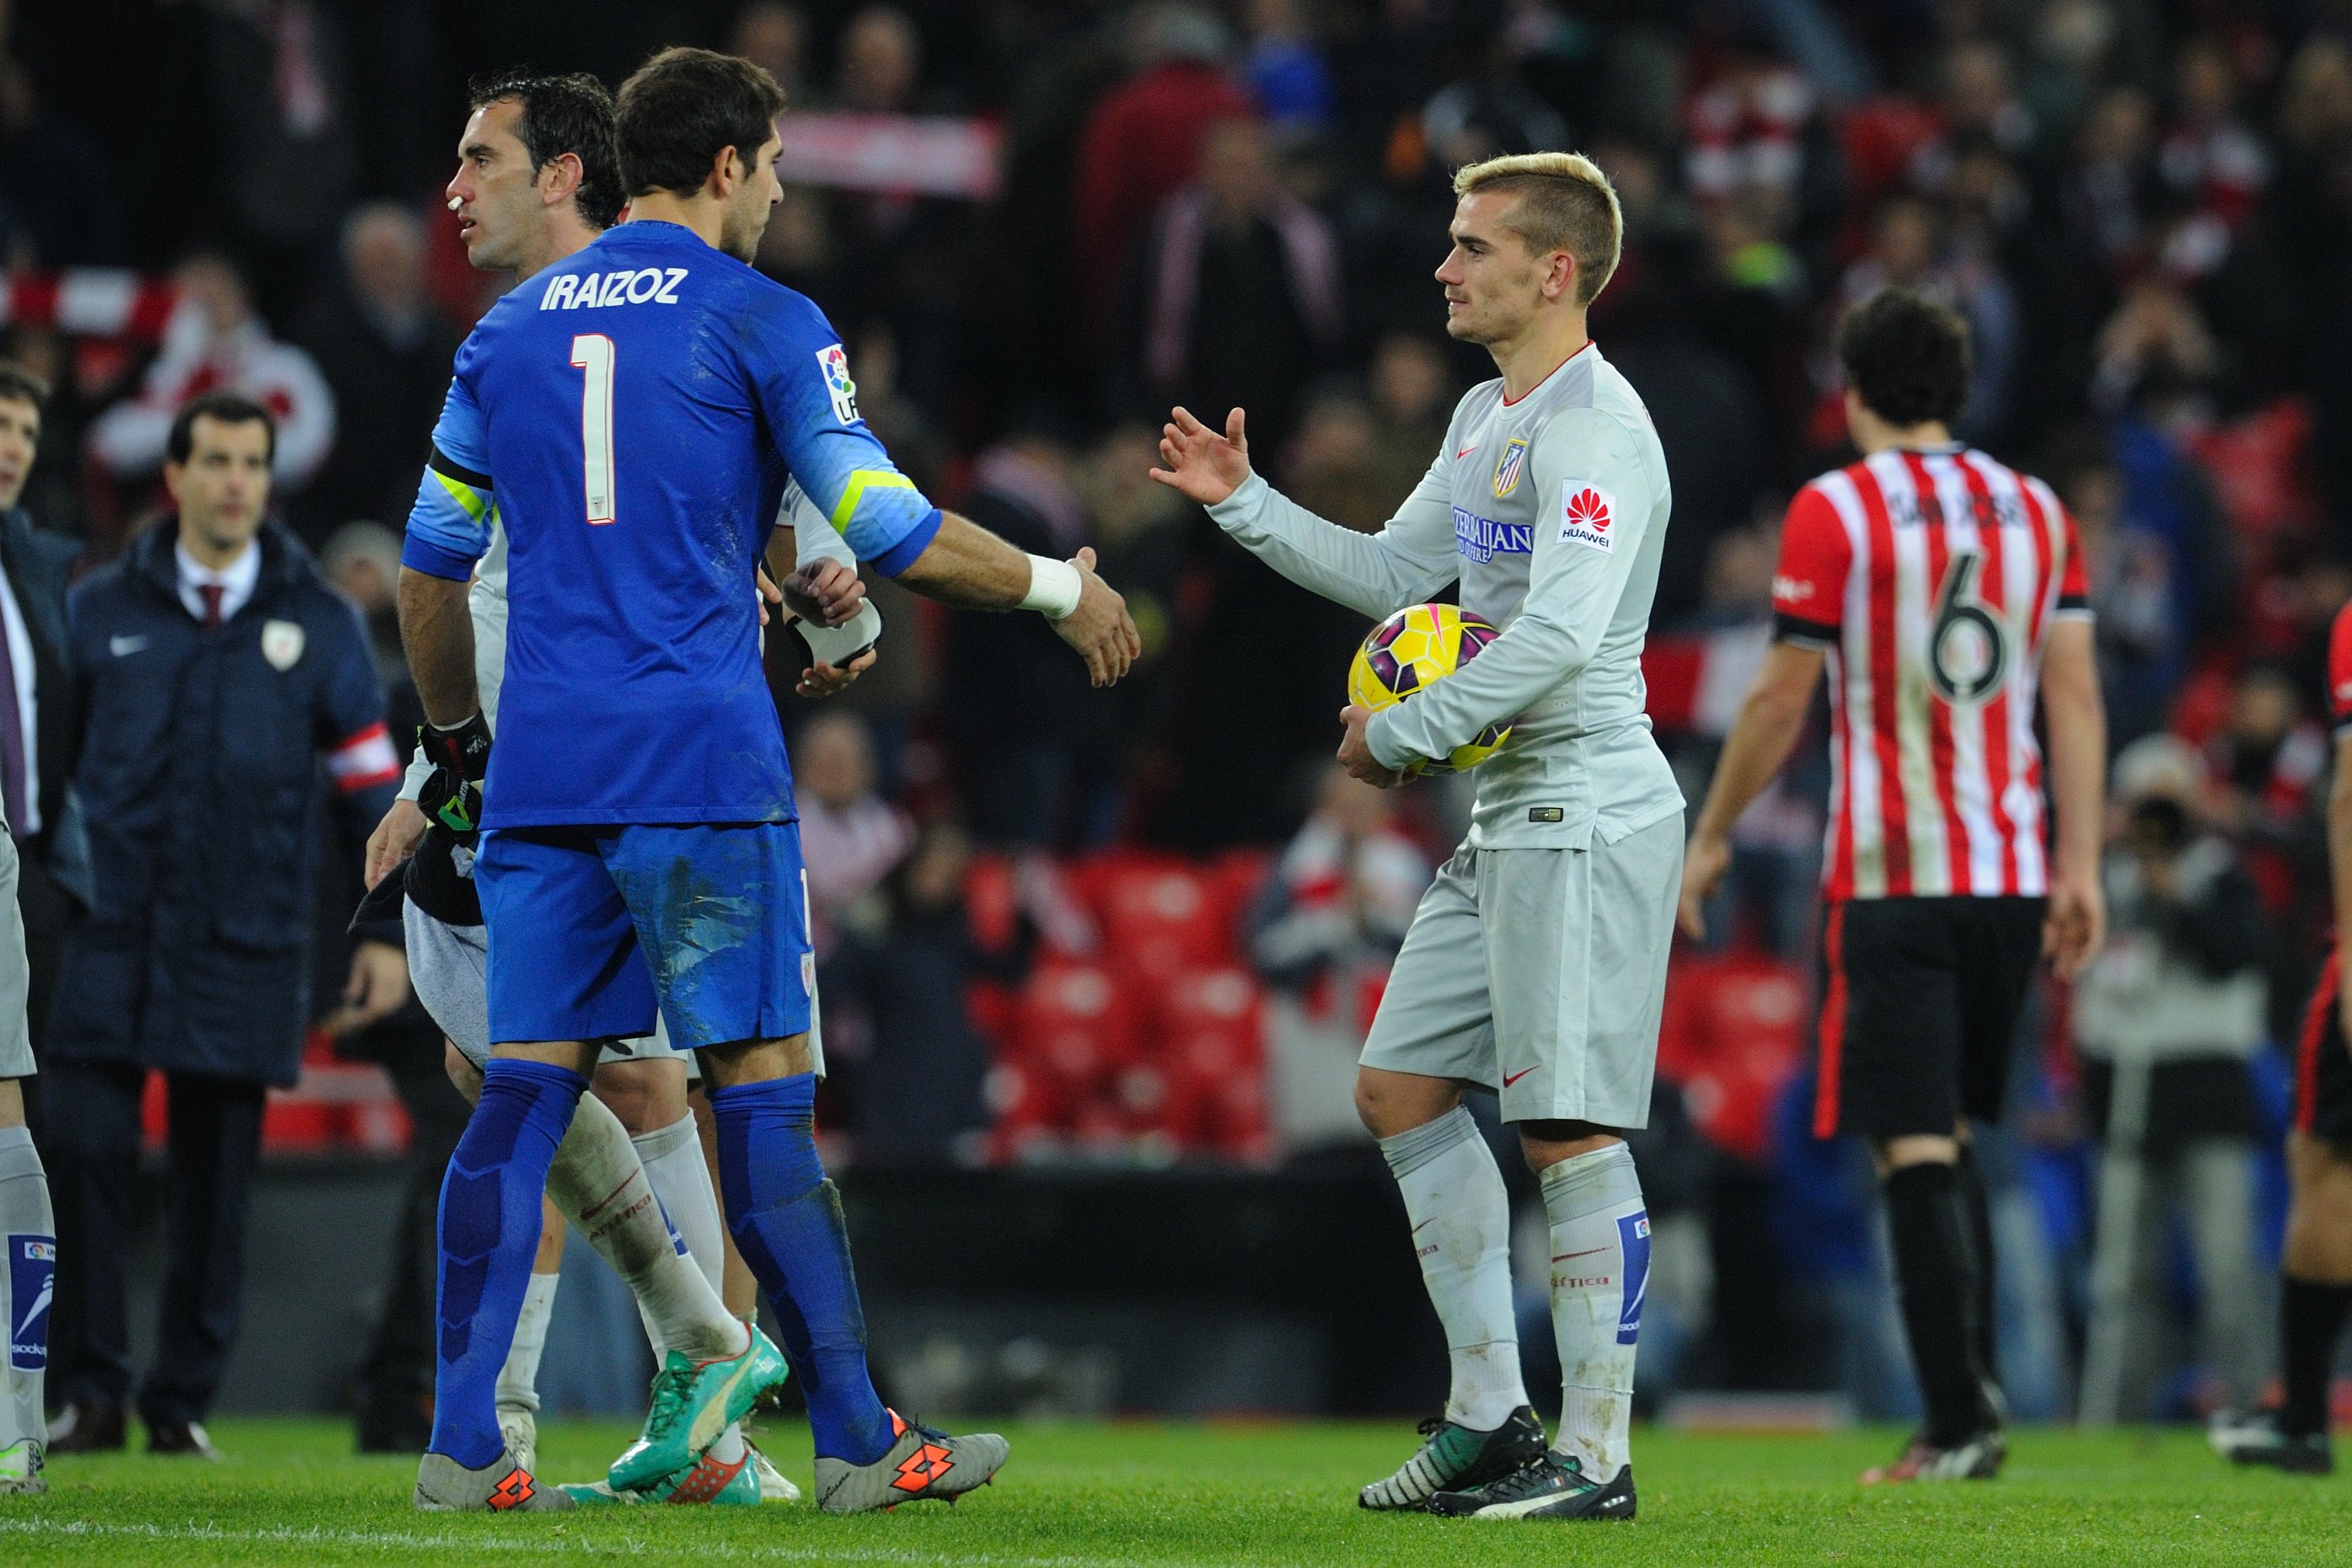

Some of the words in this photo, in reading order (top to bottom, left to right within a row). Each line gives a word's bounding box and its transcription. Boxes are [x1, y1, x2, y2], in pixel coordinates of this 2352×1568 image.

[539, 267, 688, 311] IRAIZOZ
[569, 333, 616, 525] 1
[837, 395, 857, 421] LF
[1452, 508, 1533, 560] ZERBAIJAN
[1562, 528, 1610, 548] HUAWEI
[1929, 552, 2008, 701] 6
